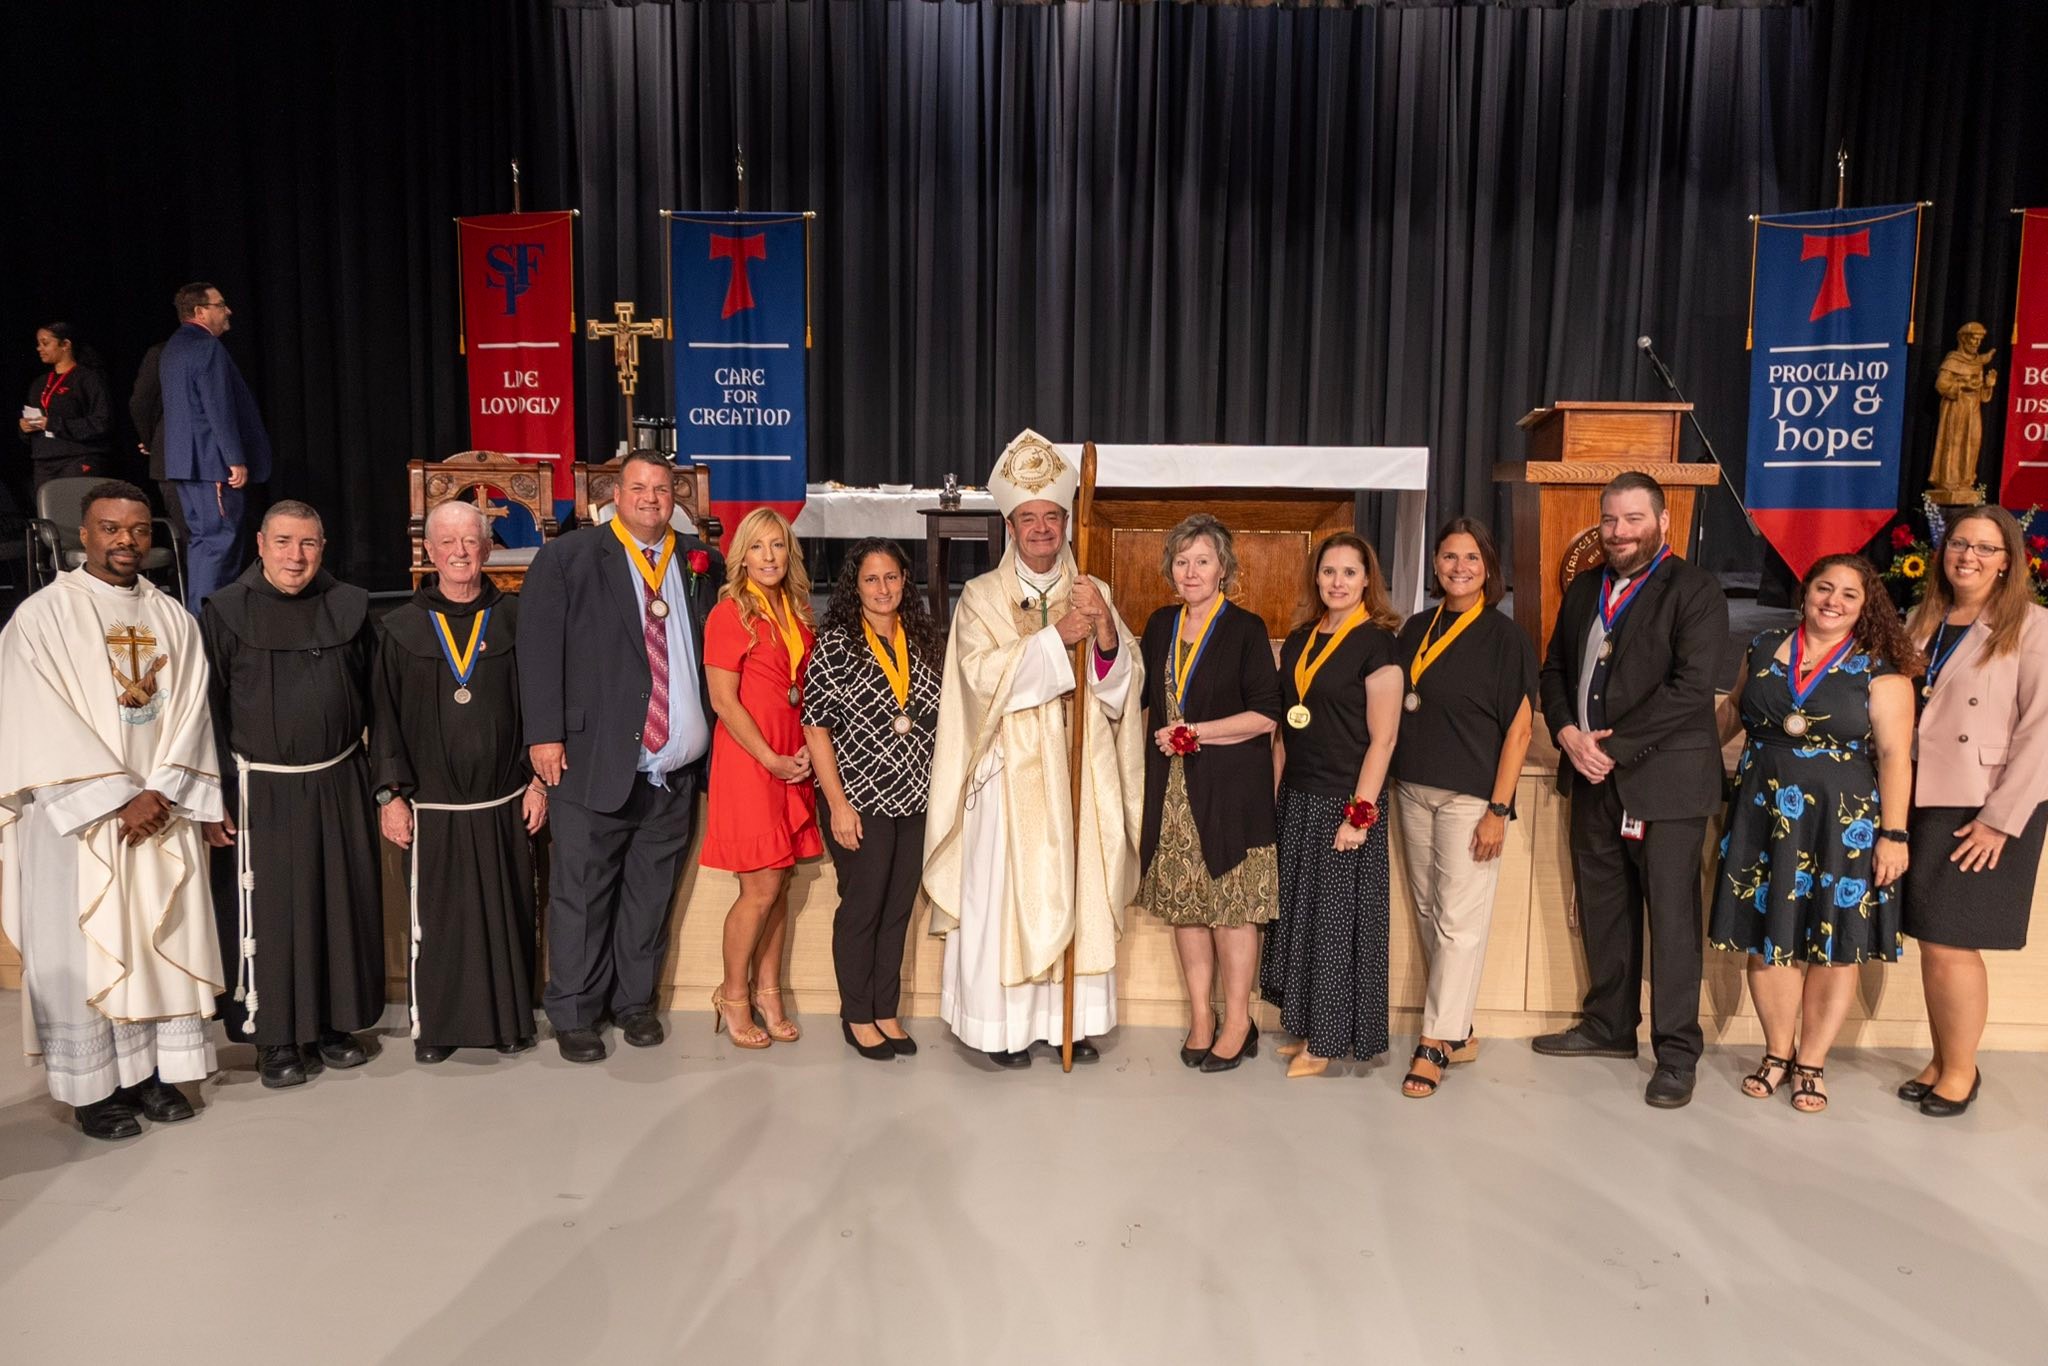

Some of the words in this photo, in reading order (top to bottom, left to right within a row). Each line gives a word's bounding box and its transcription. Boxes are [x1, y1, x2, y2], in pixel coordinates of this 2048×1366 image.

[714, 367, 766, 386] CARE
[1768, 361, 1889, 383] PROCLAIM
[480, 396, 560, 415] LOVGLY
[723, 389, 759, 404] FOR
[1768, 385, 1839, 420] JOY
[1852, 382, 1884, 415] &
[688, 407, 791, 426] CREATION
